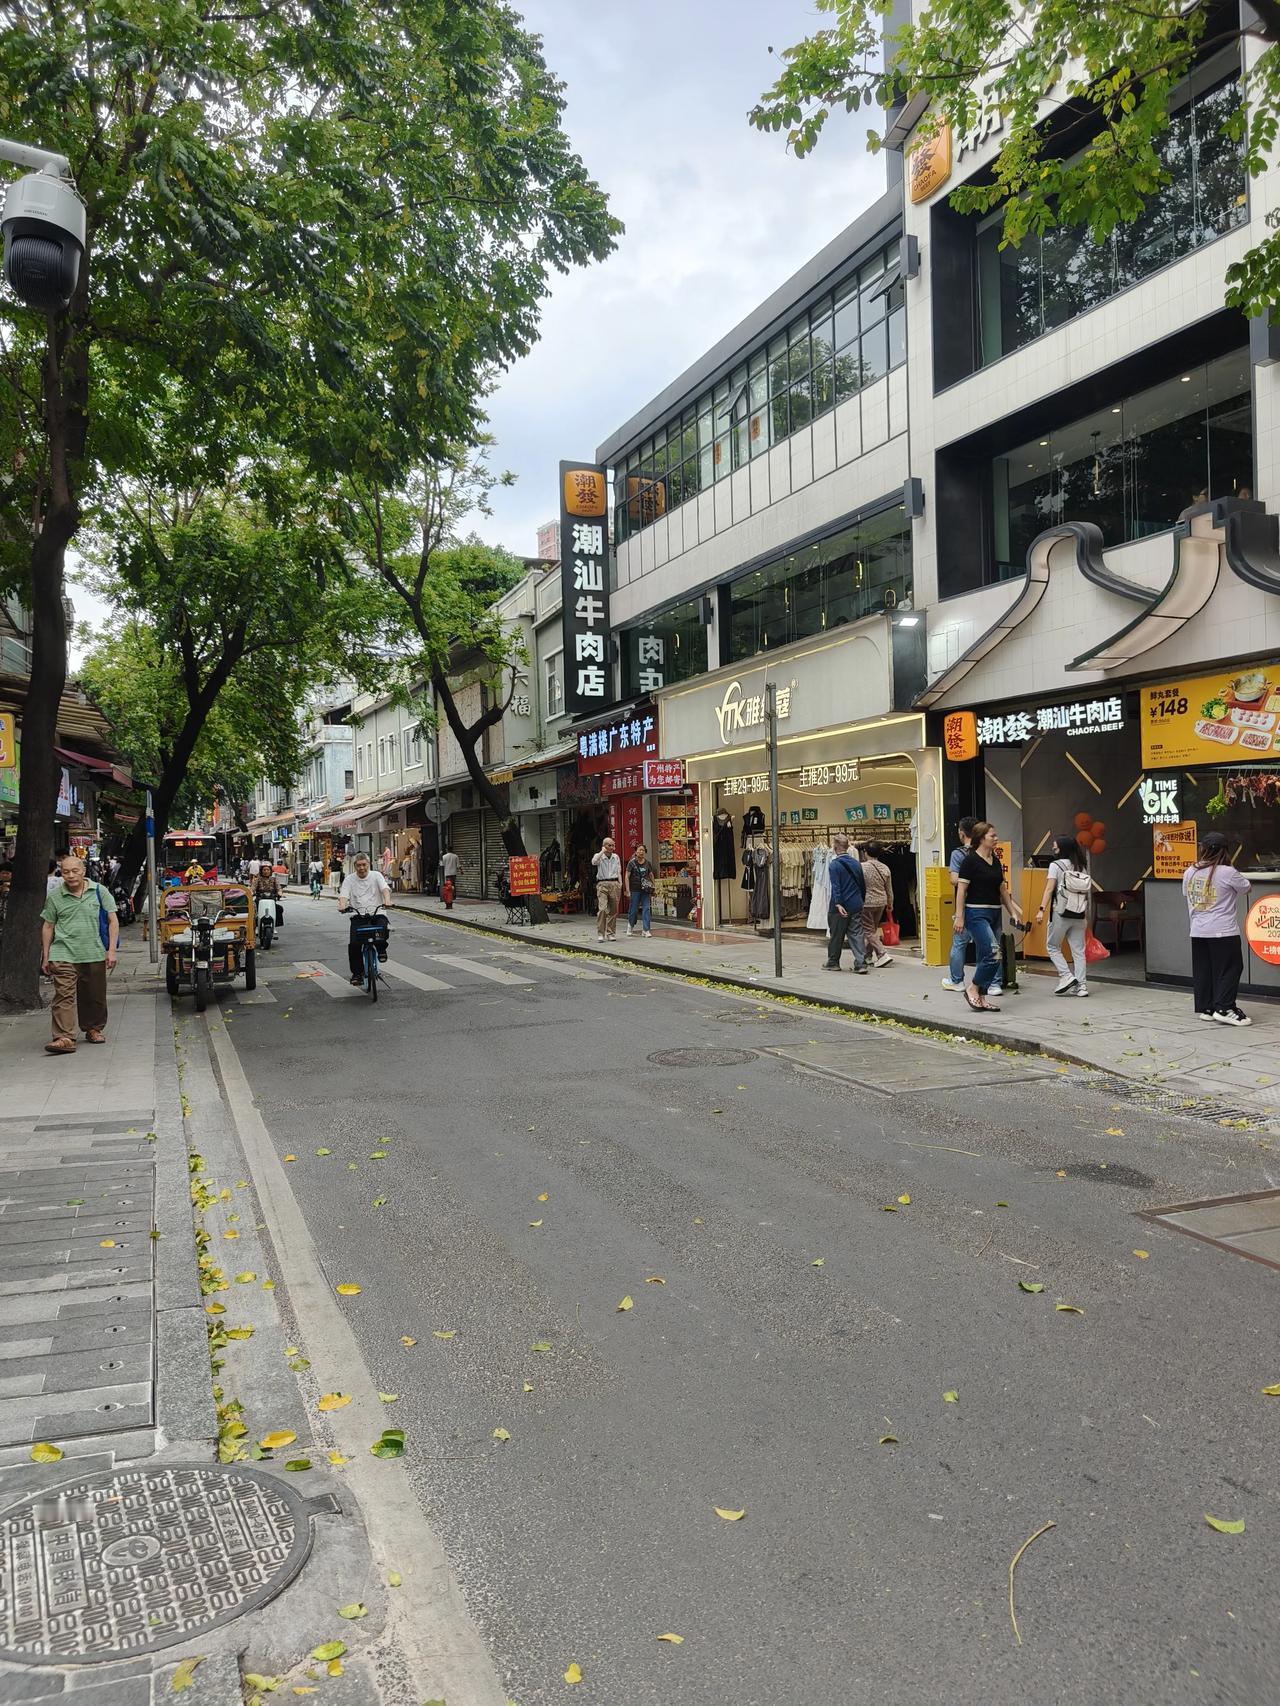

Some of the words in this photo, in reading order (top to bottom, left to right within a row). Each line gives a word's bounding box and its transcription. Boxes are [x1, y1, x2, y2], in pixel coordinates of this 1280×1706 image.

[575, 474, 599, 505] 潮發
[572, 523, 605, 697] 潮汕牛肉店
[976, 711, 1037, 745] 潮發
[1036, 697, 1122, 730] 潮汕牛肉店
[1067, 726, 1101, 736] CHAOFA
[1101, 721, 1125, 732] BEEF
[946, 717, 965, 750] 潮發
[800, 763, 859, 788] 主推29-99元
[1155, 779, 1178, 791] TIME
[724, 776, 770, 796] 主推29-99元
[805, 810, 815, 819] 59
[850, 810, 863, 821] 39
[877, 807, 888, 818] 29
[1142, 815, 1180, 824] 3小时牛肉
[48, 1532, 82, 1607] 中国电信
